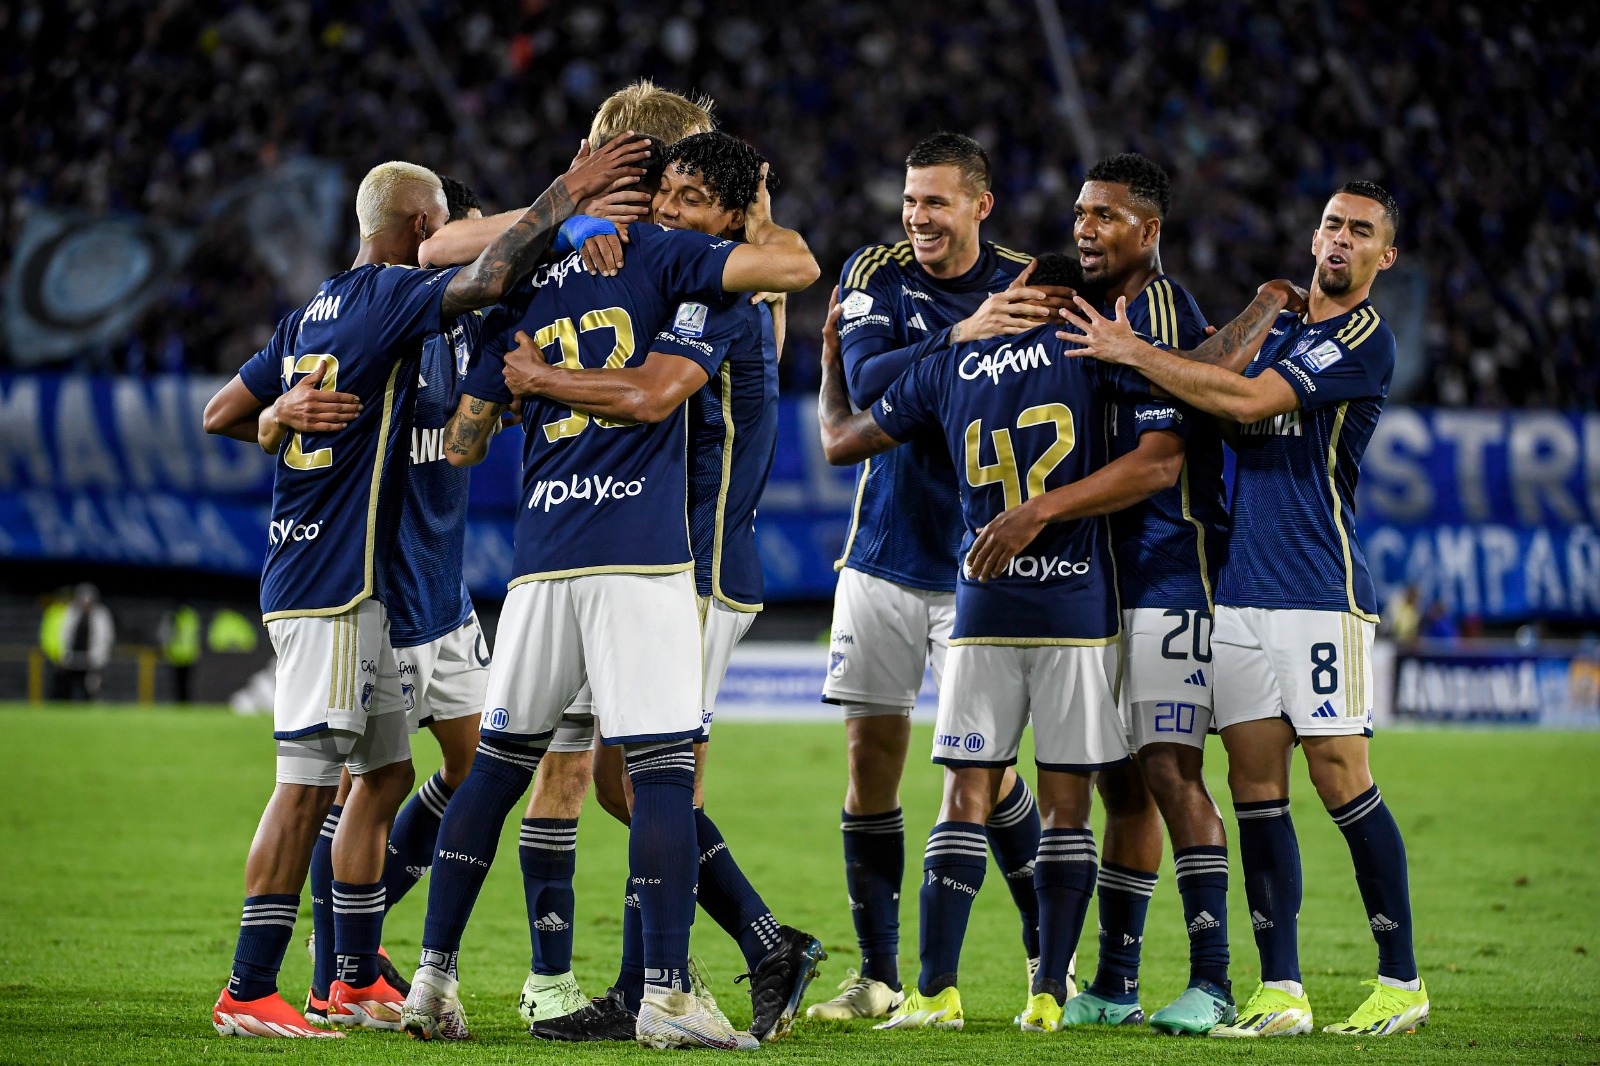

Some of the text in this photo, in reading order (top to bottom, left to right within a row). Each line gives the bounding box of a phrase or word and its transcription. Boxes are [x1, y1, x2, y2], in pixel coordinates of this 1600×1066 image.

[964, 402, 1076, 512] 42
[1161, 608, 1213, 664] 20
[1310, 642, 1338, 695] 8
[1155, 702, 1196, 734] 20
